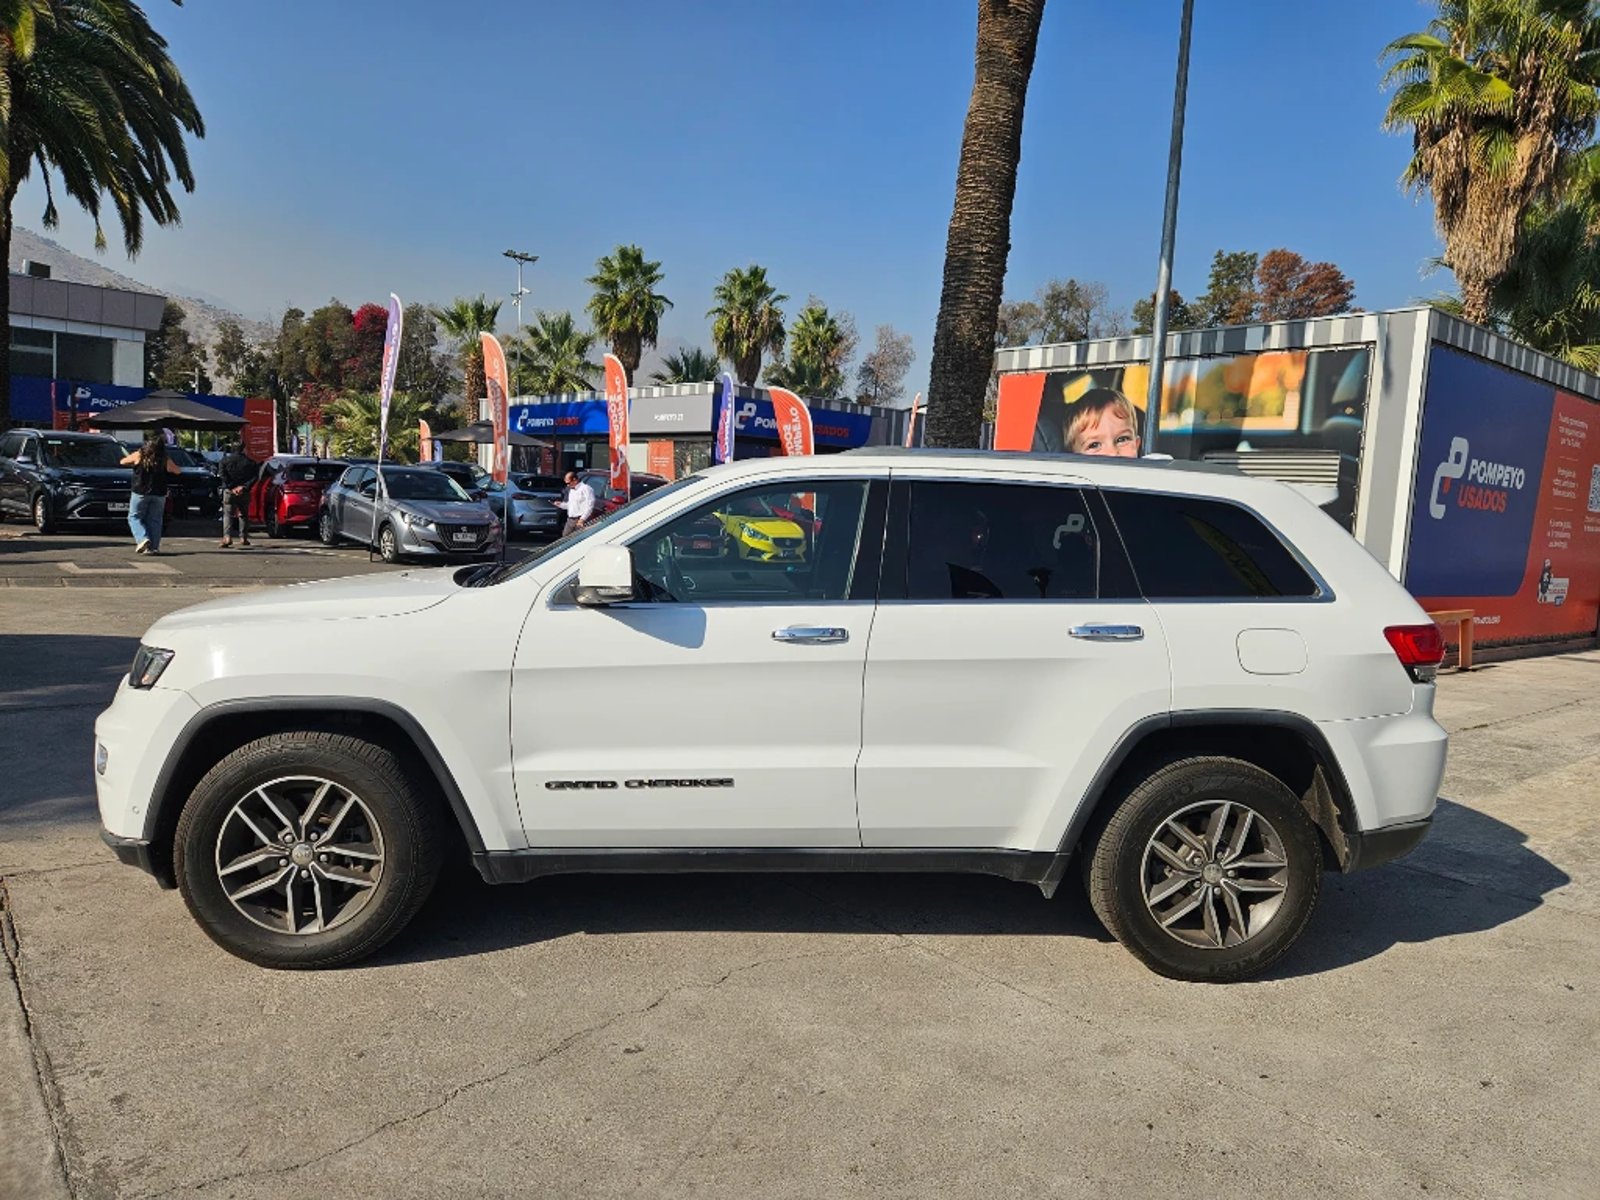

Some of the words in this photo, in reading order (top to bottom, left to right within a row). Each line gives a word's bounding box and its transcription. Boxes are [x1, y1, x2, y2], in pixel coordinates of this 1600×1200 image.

[1468, 459, 1525, 490] POMPEYO
[1457, 484, 1508, 513] USADOS
[545, 780, 618, 790] GRAND
[624, 778, 734, 788] CHEROKEE
